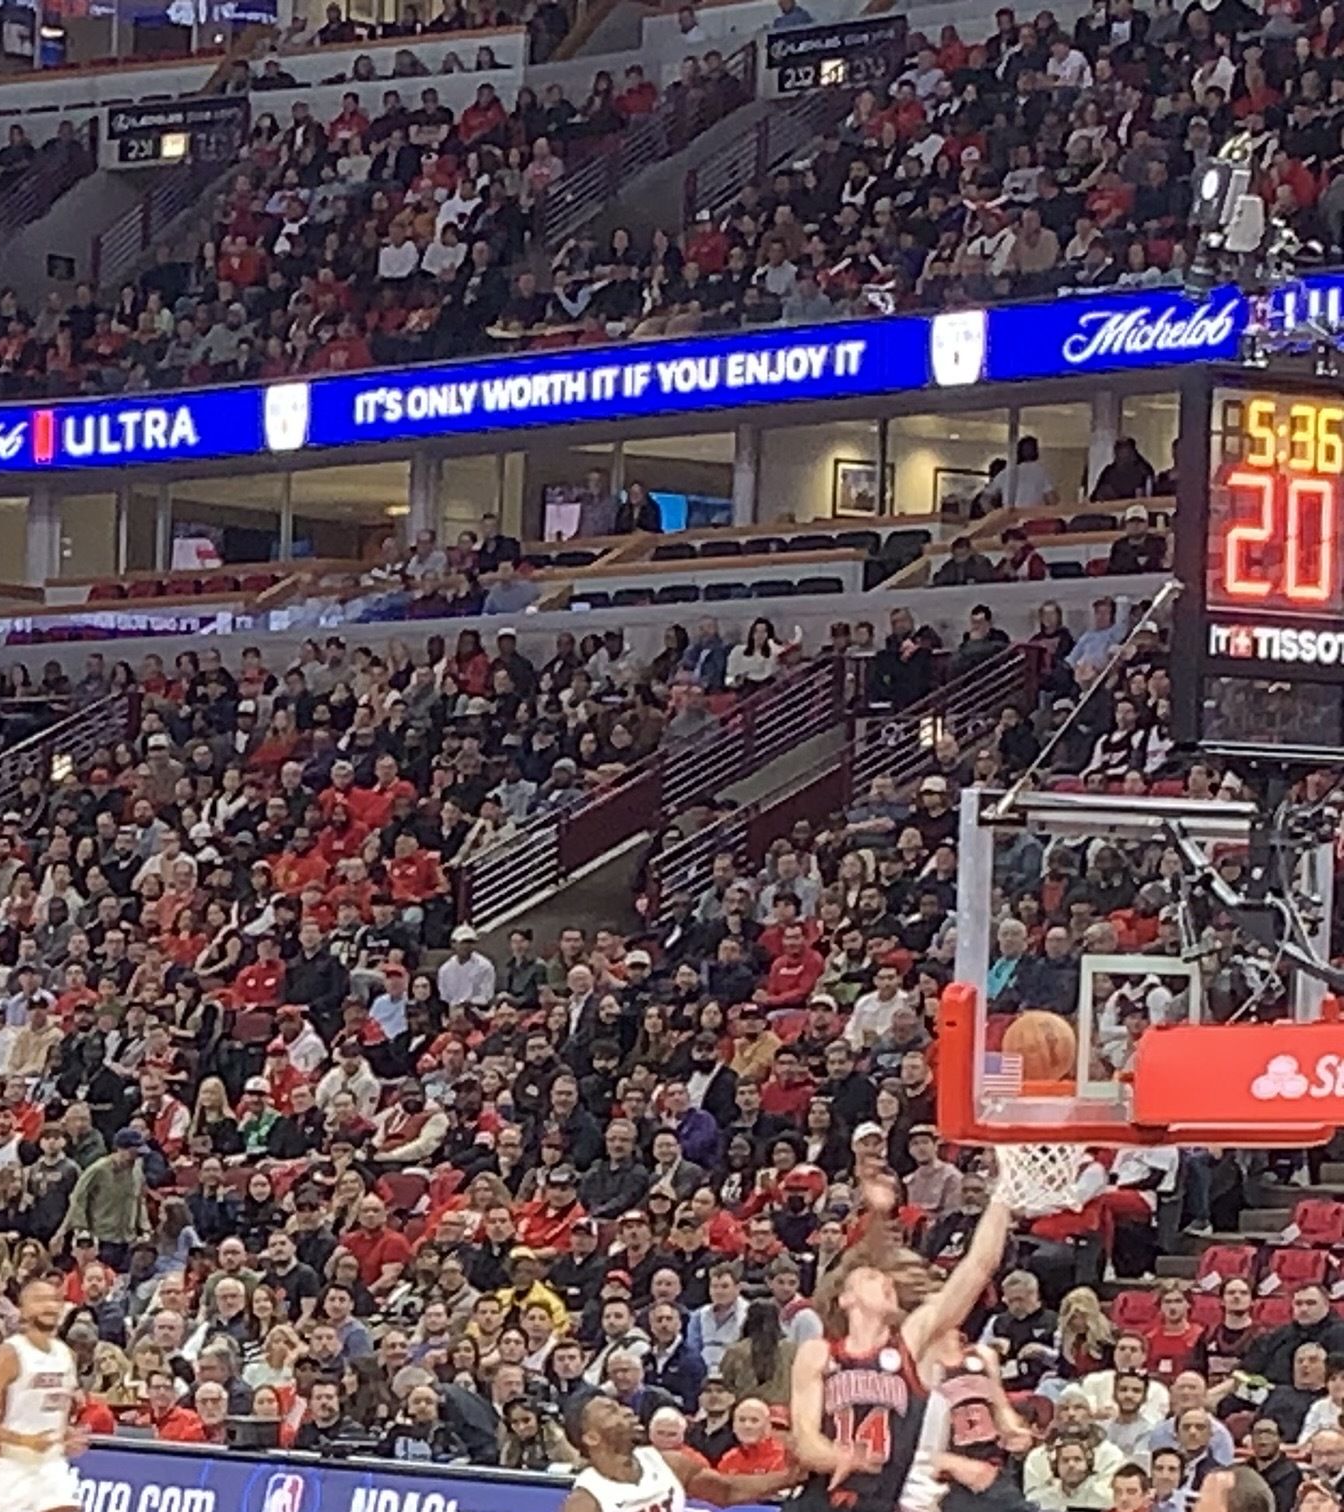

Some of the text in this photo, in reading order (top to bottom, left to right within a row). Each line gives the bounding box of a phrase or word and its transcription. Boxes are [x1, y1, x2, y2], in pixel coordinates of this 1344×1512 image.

[1063, 297, 1238, 363] Michelob
[355, 340, 866, 425] IT'S ONLY WORTH IT IF YOU ENJOY IT
[64, 406, 200, 457] ULTRA
[1247, 400, 1343, 473] 5:36
[1224, 472, 1333, 598] 20
